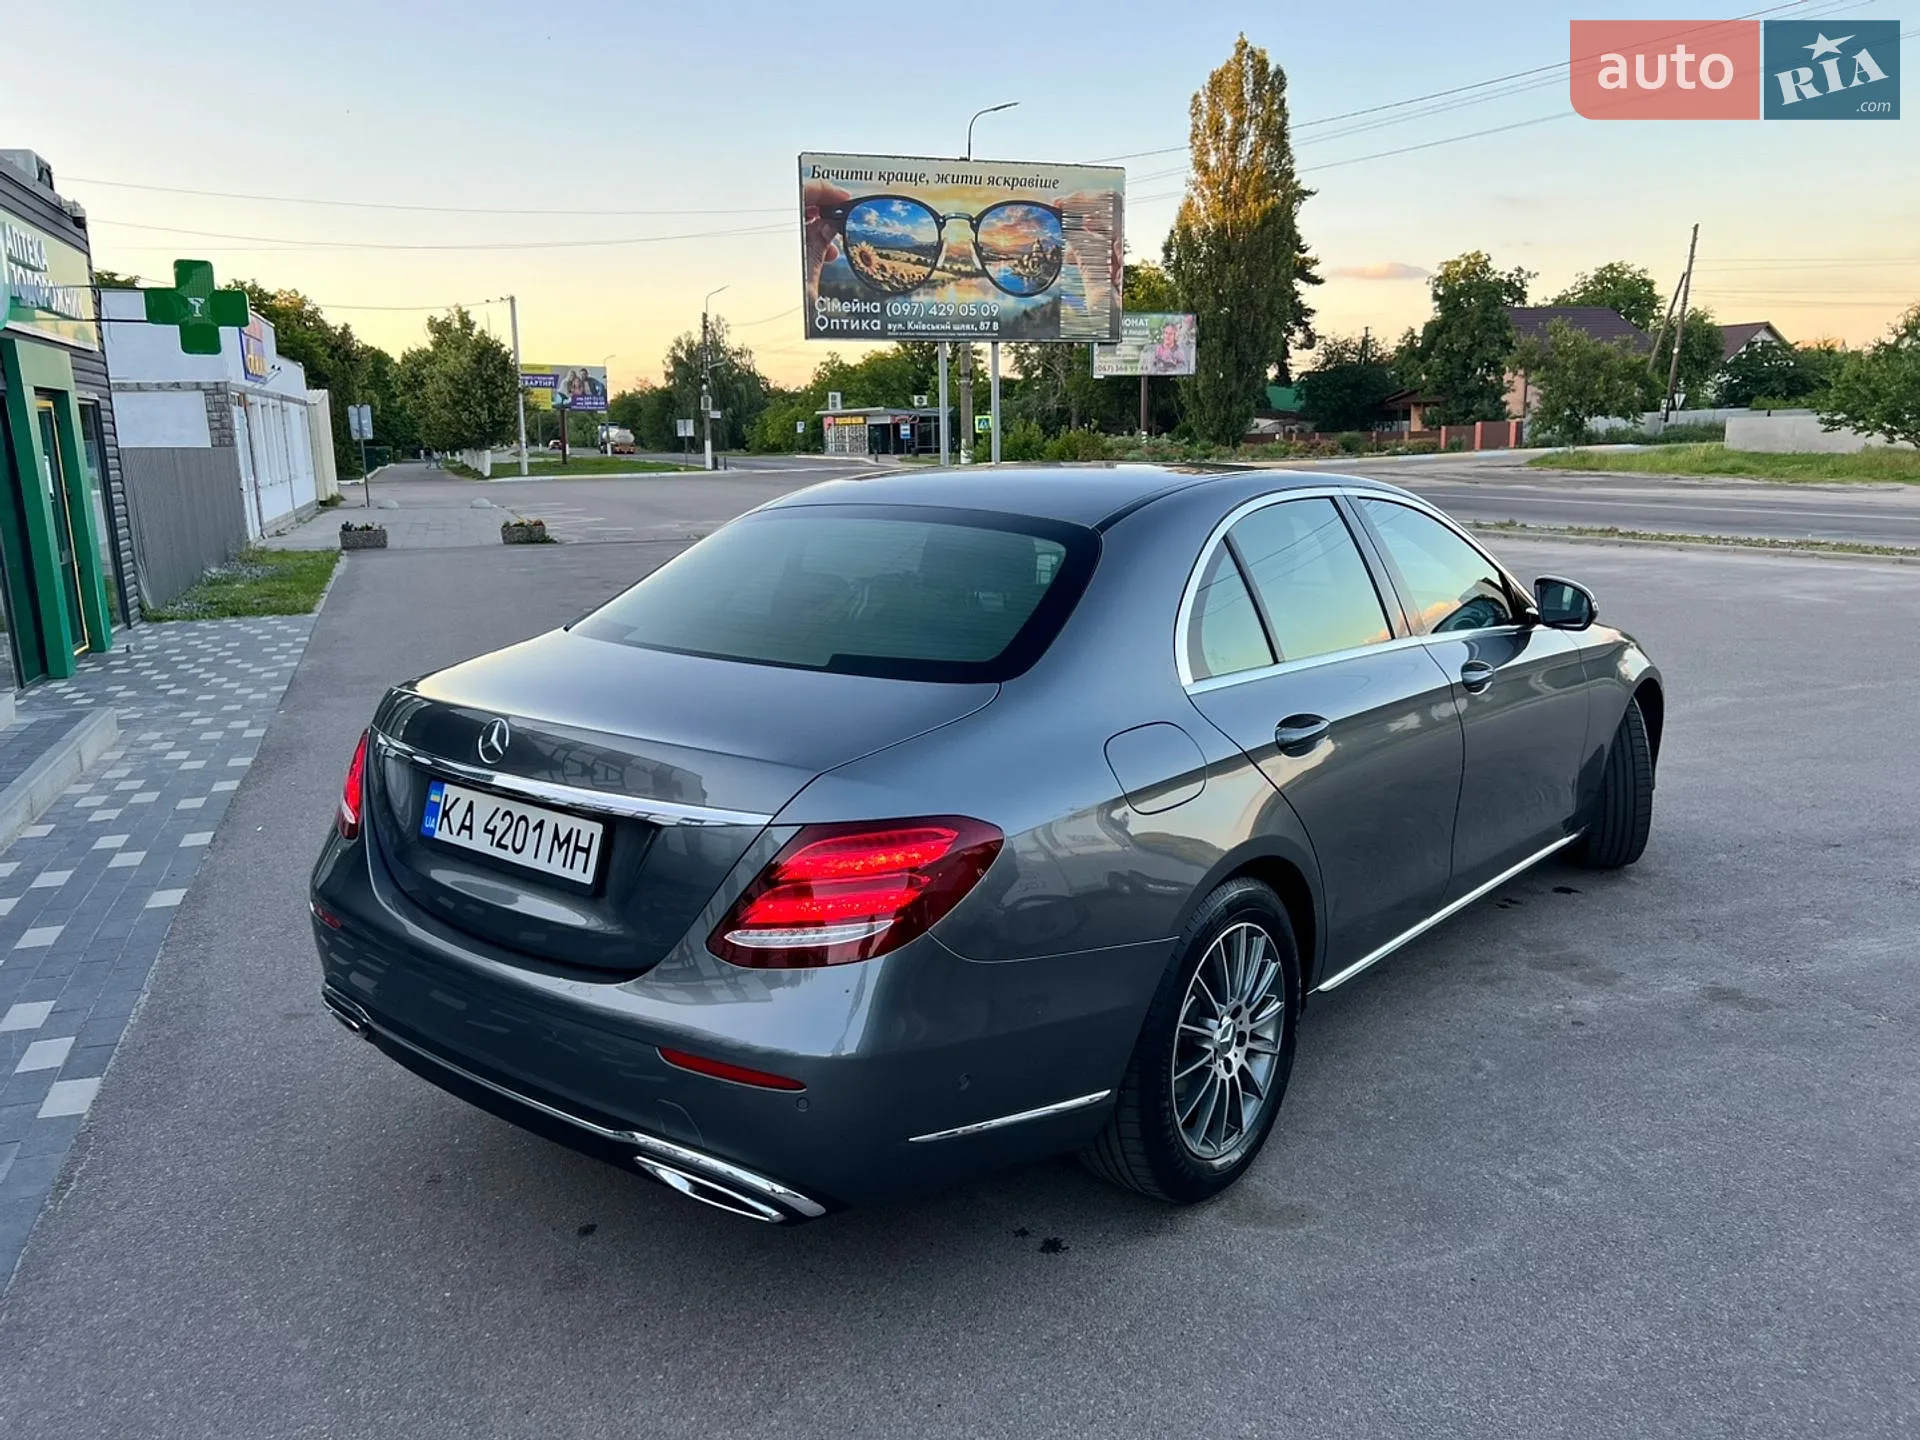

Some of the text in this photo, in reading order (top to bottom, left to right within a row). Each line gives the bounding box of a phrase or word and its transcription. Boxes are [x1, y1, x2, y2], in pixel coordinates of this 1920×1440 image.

[810, 164, 1060, 190] Бачити краще, жити яскравіше
[6, 222, 50, 272] АПТЕКА
[814, 296, 881, 314] Сімейна
[885, 301, 1000, 318] (097) 429 05 09
[814, 315, 881, 332] Оптика
[887, 322, 905, 332] вул.
[907, 320, 951, 331] Київський
[952, 322, 978, 332] шлях,
[424, 817, 436, 830] UA
[483, 807, 546, 860] 4201
